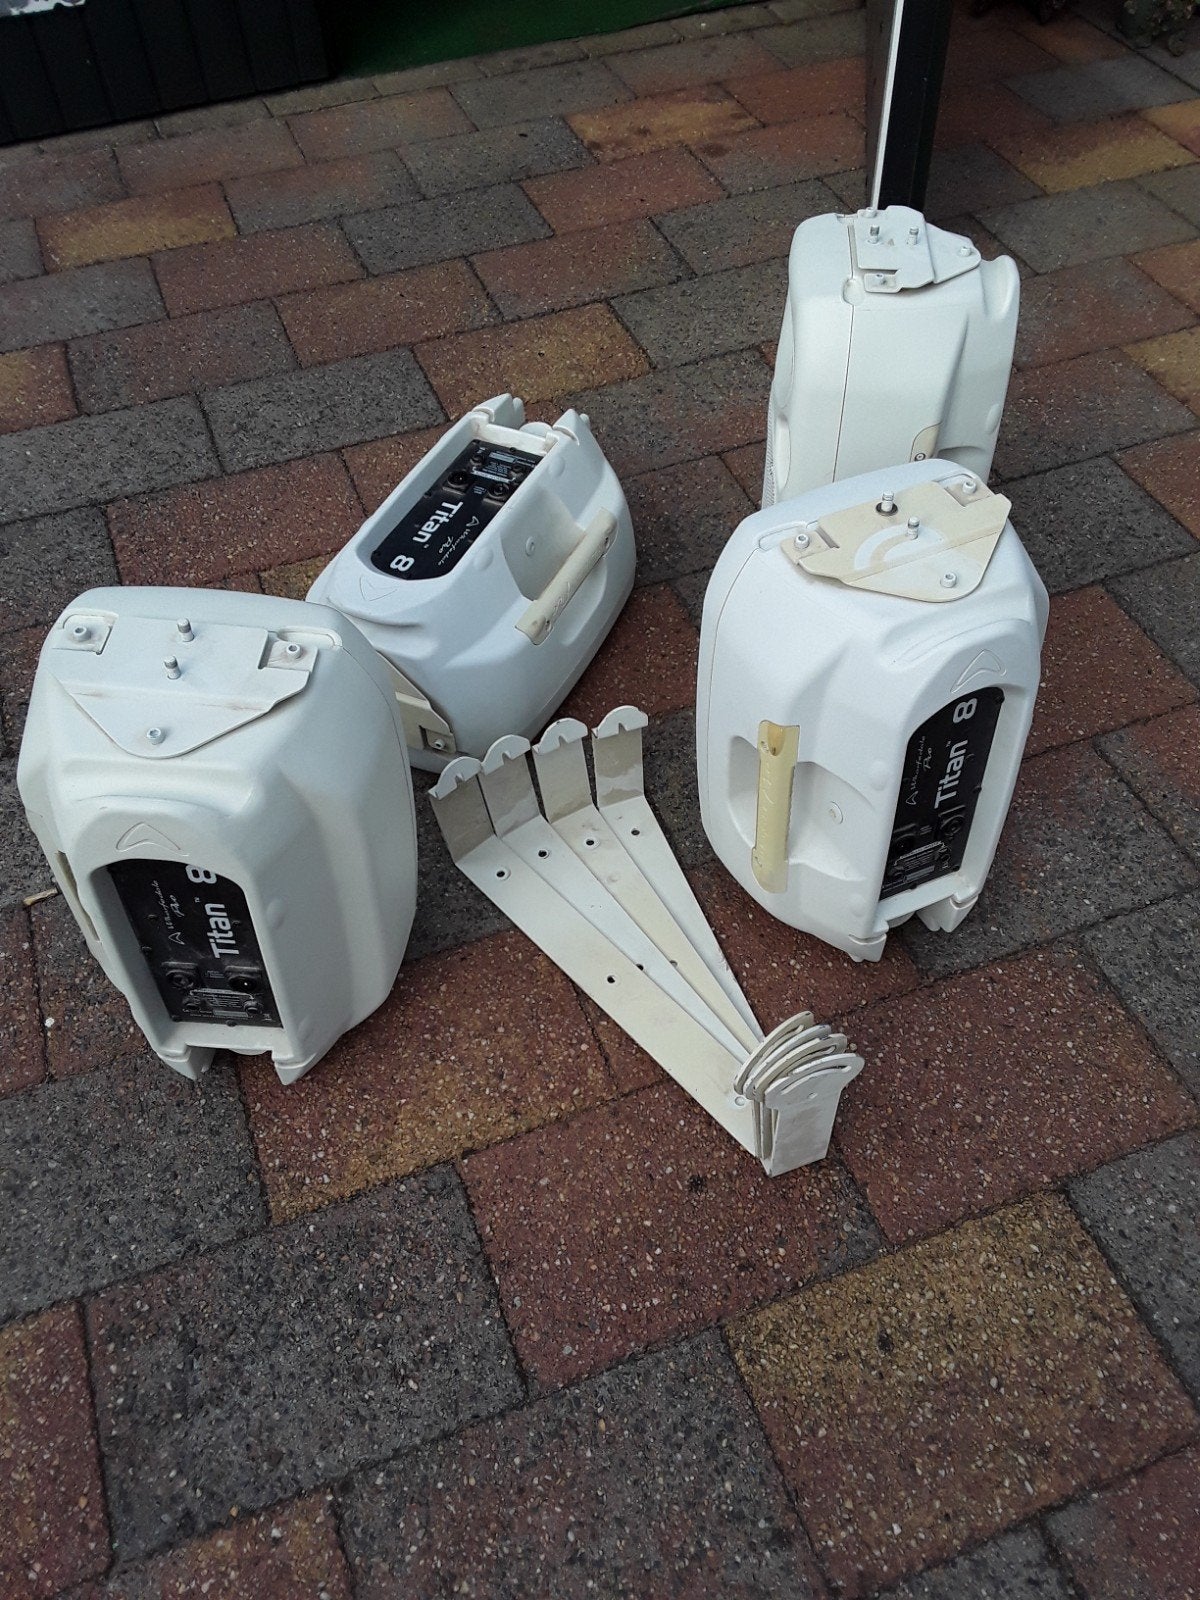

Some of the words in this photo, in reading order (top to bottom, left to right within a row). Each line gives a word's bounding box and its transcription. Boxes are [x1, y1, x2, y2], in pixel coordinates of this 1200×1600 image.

[412, 501, 464, 543] Titan
[389, 554, 415, 572] 8
[934, 739, 969, 809] Titan
[952, 697, 978, 724] 8
[185, 864, 217, 885] 8
[204, 903, 240, 959] Titan
